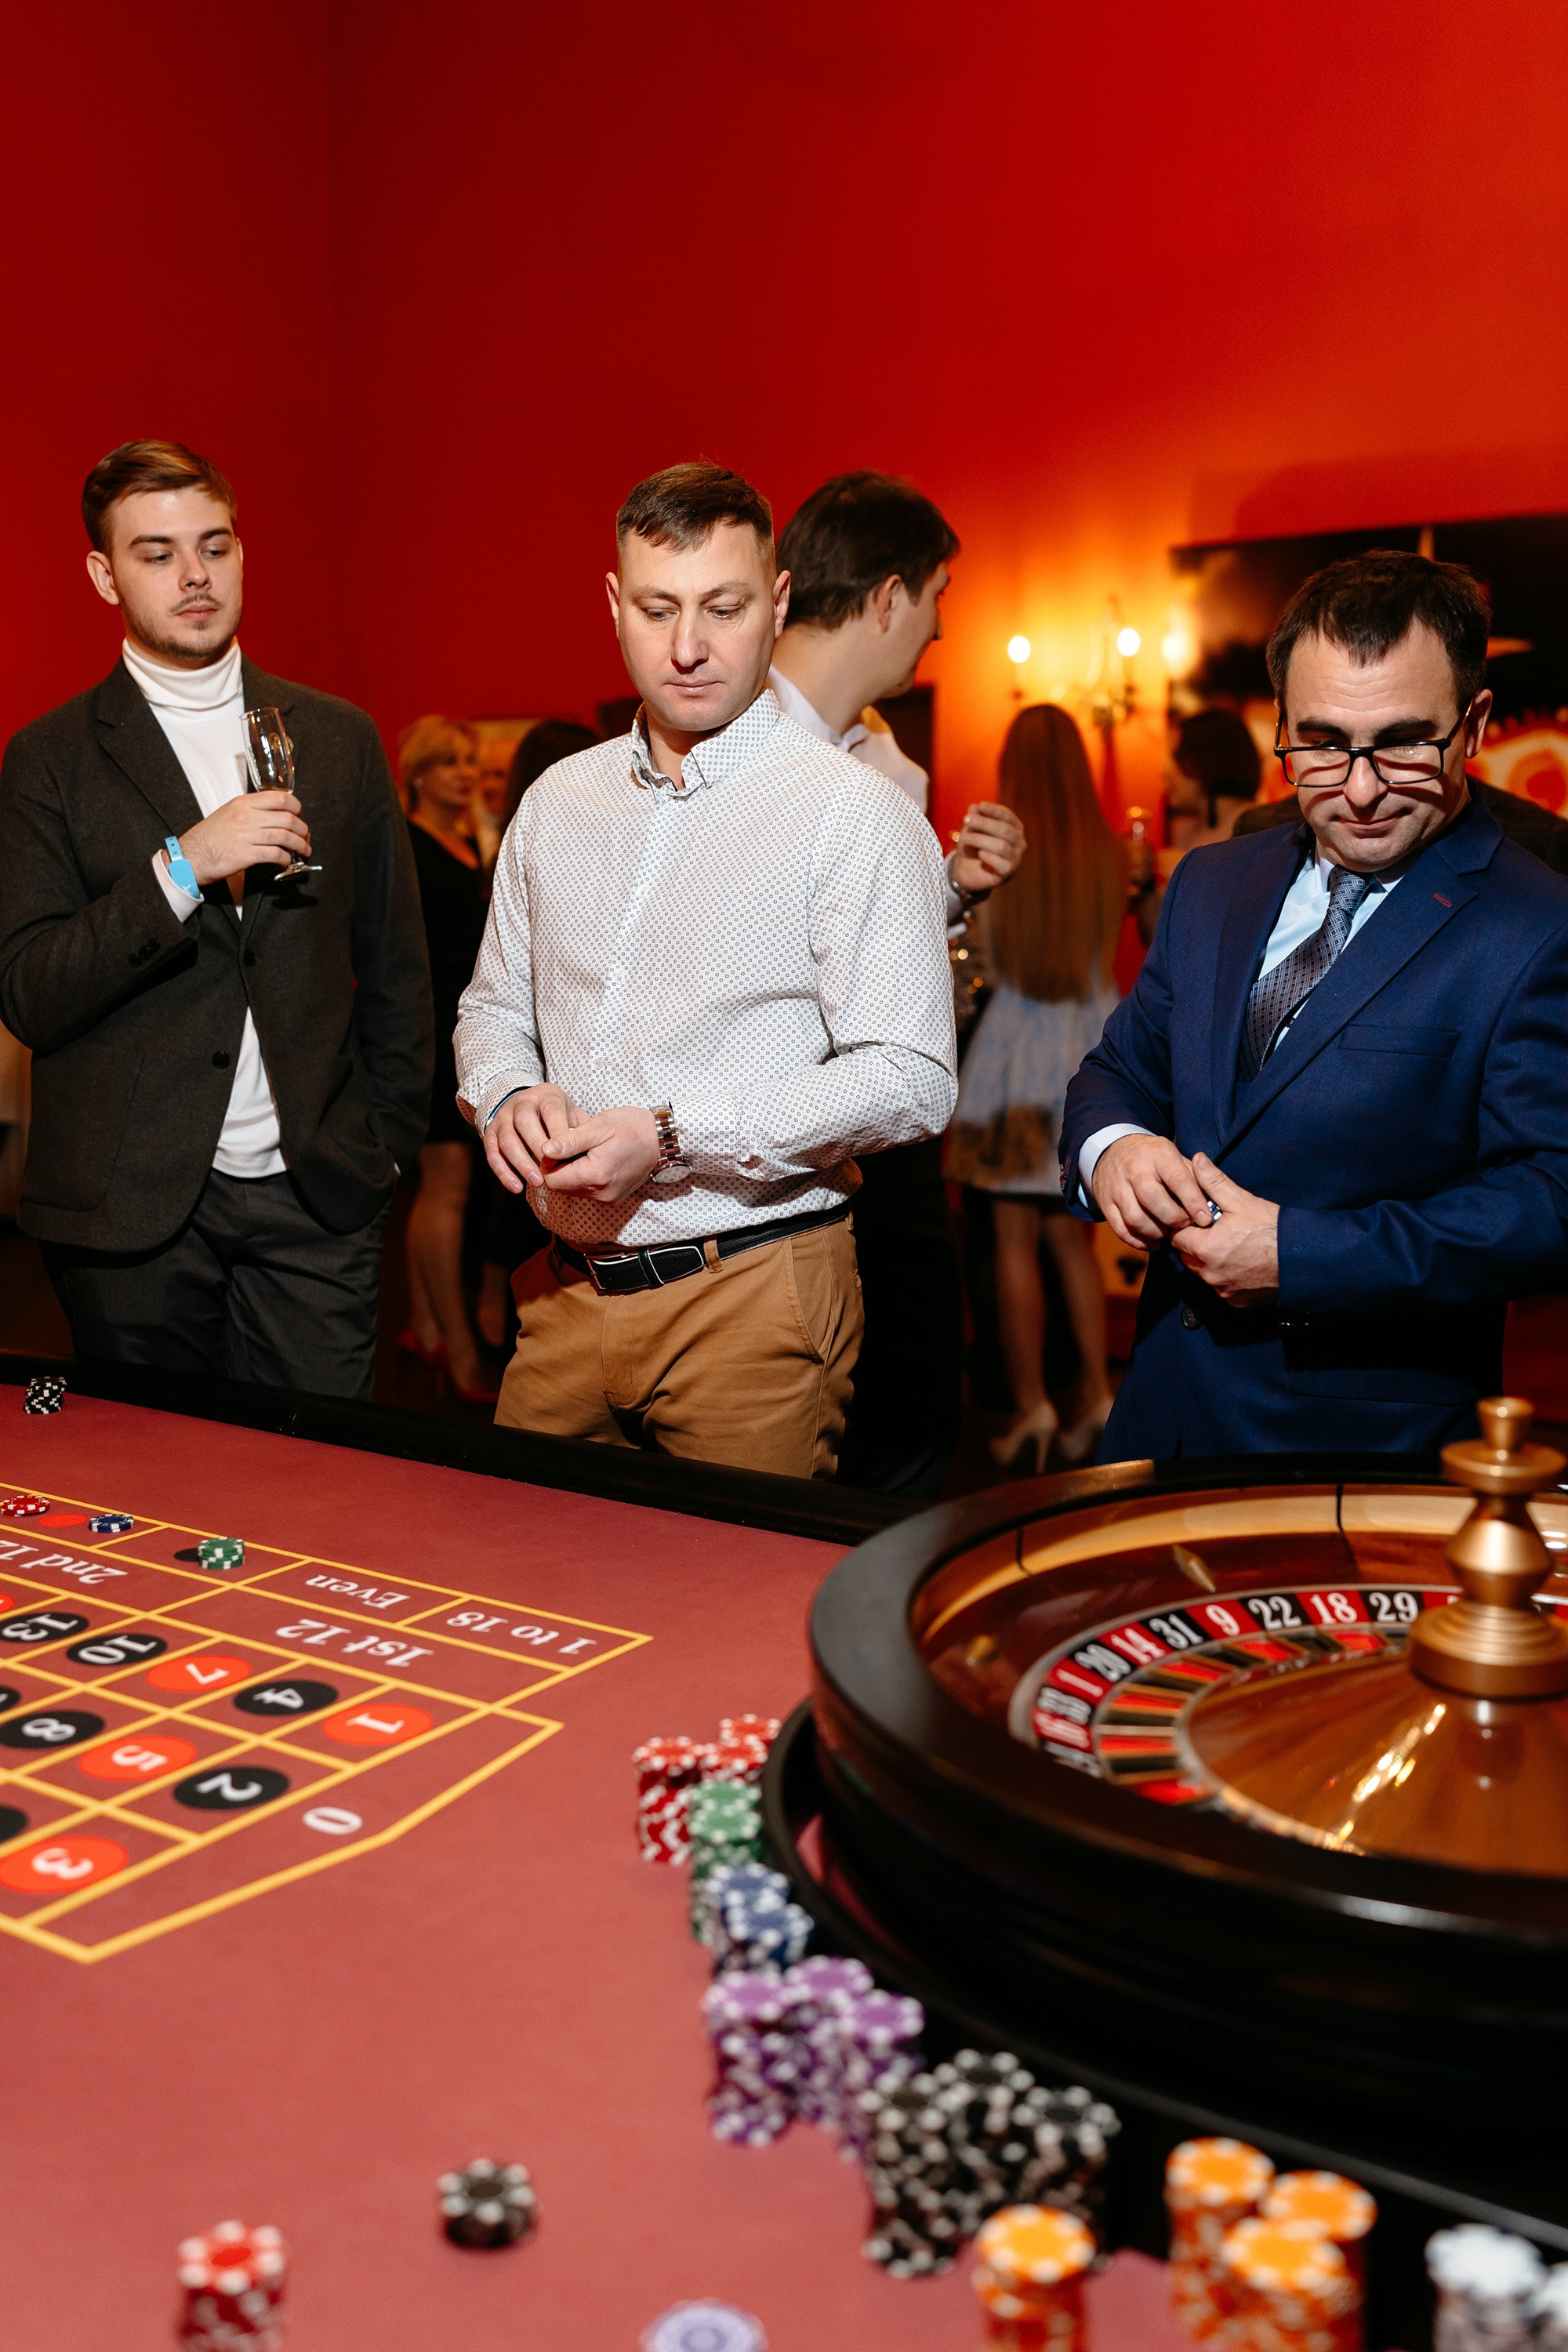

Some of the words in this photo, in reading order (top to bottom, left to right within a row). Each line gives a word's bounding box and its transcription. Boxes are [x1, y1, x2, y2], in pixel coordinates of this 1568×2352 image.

[19, 1553, 128, 1584] 2nd
[305, 1574, 410, 1609] Even
[2, 1613, 78, 1641] 13
[275, 1618, 351, 1645] 12
[446, 1611, 509, 1632] 18
[510, 1625, 560, 1645] to
[78, 1635, 158, 1664] 10
[341, 1635, 434, 1667] 1st
[558, 1637, 597, 1654] 1
[1056, 1669, 1104, 1697] 1
[1110, 1628, 1166, 1664] 14
[1149, 1613, 1203, 1649] 31
[1205, 1604, 1240, 1636] 9
[1247, 1595, 1302, 1630] 22
[1309, 1592, 1358, 1624] 18
[1368, 1592, 1419, 1624] 29
[185, 1663, 230, 1685] 7
[252, 1688, 304, 1709] 4
[21, 1718, 77, 1742] 8
[346, 1713, 405, 1734] 1
[111, 1744, 169, 1772] 5
[196, 1773, 263, 1802] 2
[303, 1806, 363, 1835] 0
[31, 1847, 94, 1880] 3
